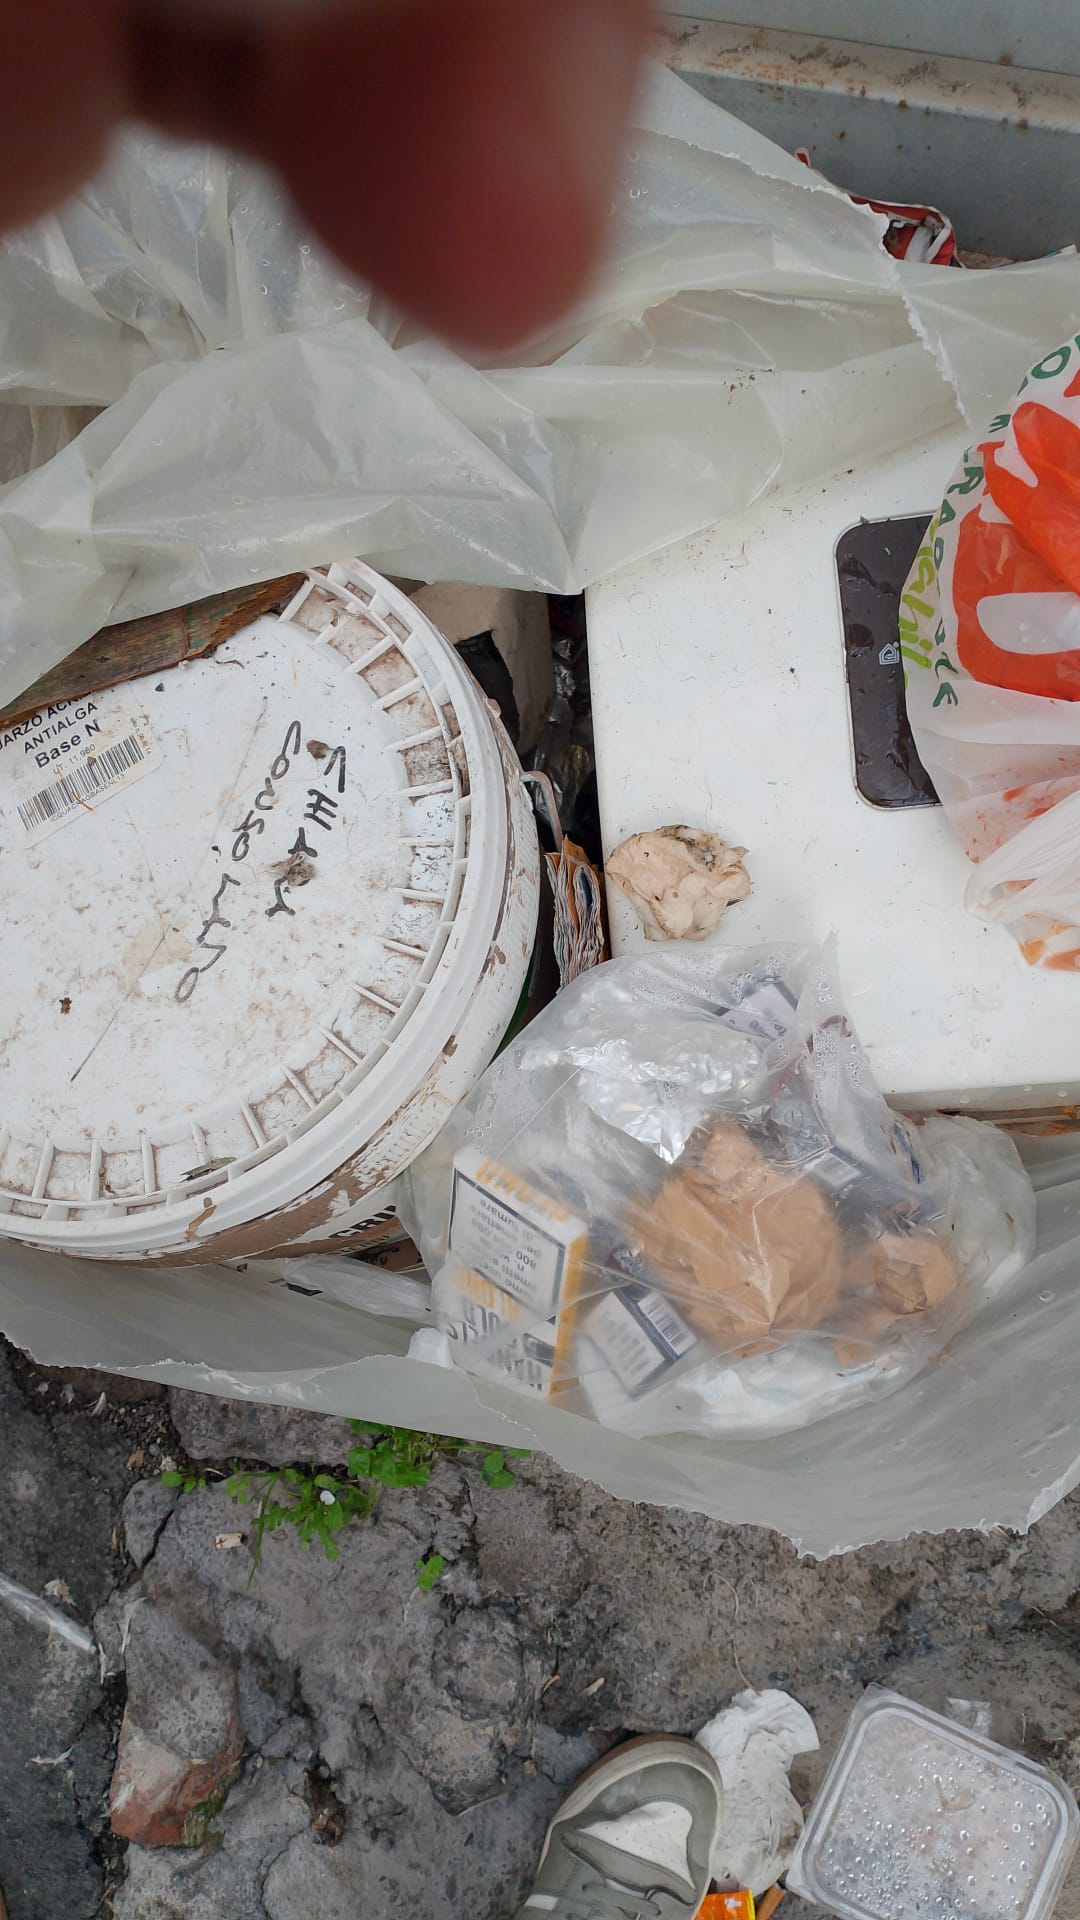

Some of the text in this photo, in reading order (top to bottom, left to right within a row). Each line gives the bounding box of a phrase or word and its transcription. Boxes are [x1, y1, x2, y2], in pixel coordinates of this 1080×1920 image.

[24, 701, 98, 754] ANTIALGA
[35, 734, 82, 768] Base
[84, 718, 101, 737] N
